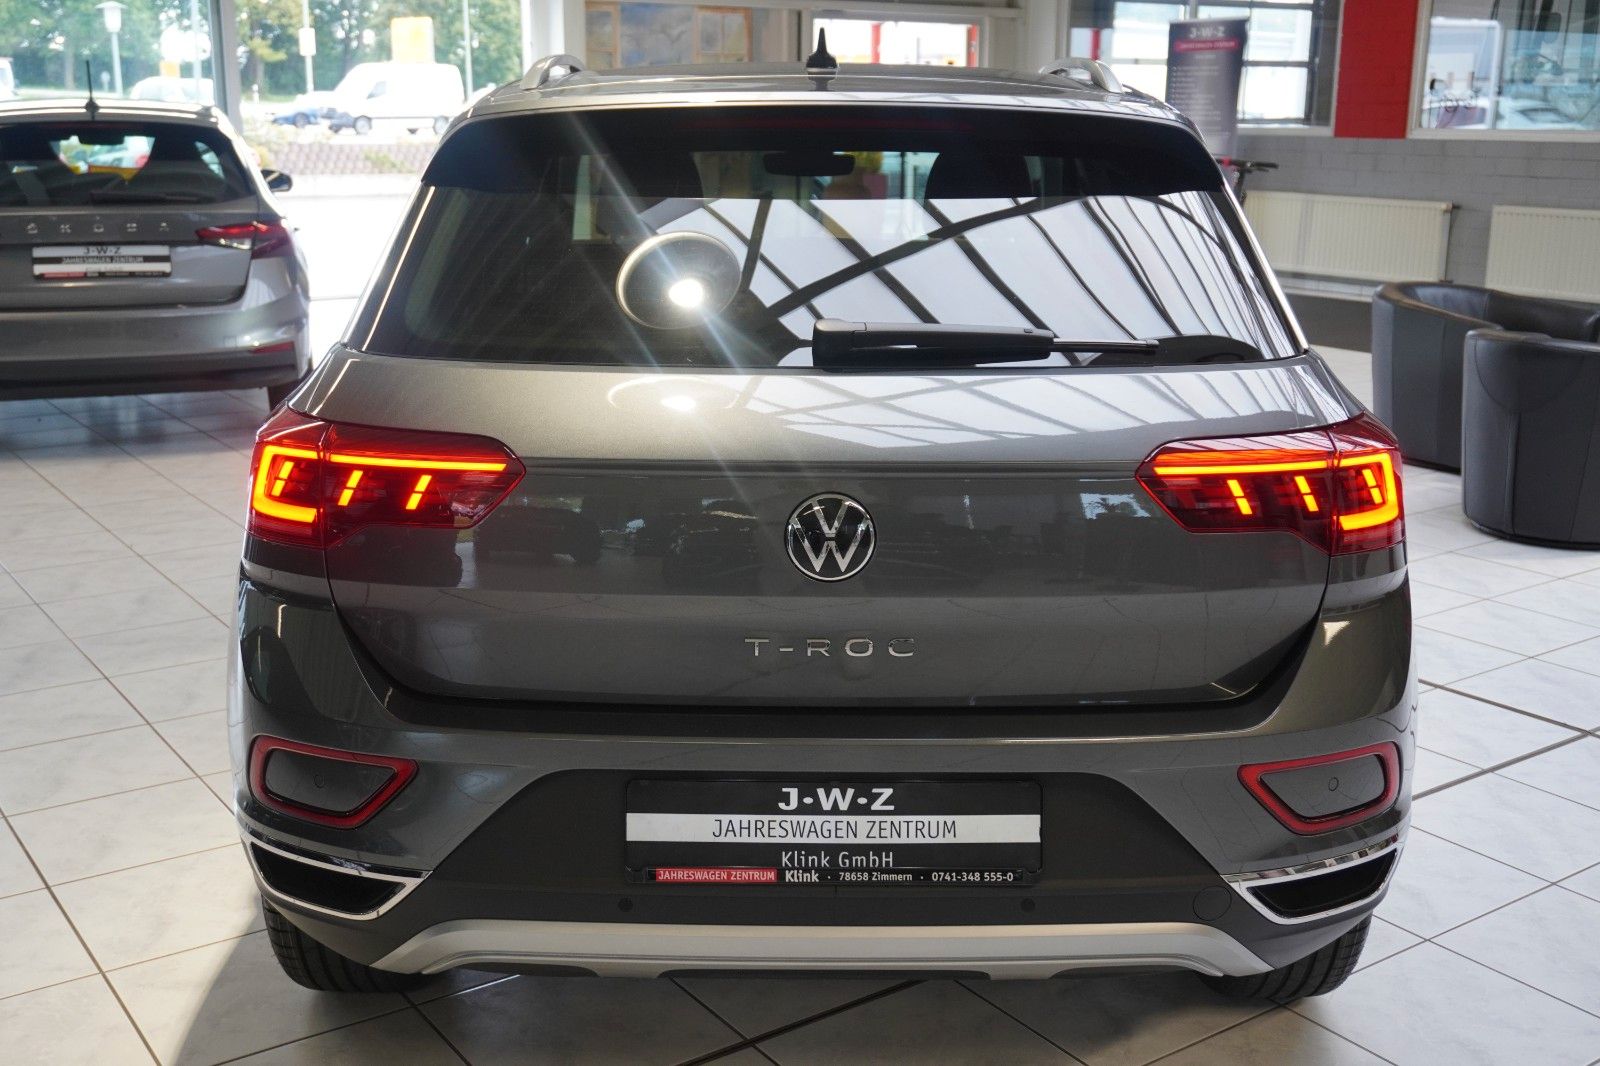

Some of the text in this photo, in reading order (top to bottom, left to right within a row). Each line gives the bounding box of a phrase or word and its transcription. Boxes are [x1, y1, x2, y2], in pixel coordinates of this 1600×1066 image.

[744, 638, 915, 657] T-ROC
[712, 819, 957, 839] JAHRESWAGEN ZENTRUM
[781, 850, 894, 868] Klink GmbH
[658, 870, 1014, 882] JAHRESWAGEN ZENTRUM Klink 78658 Zimmern 0741-348 555-0
